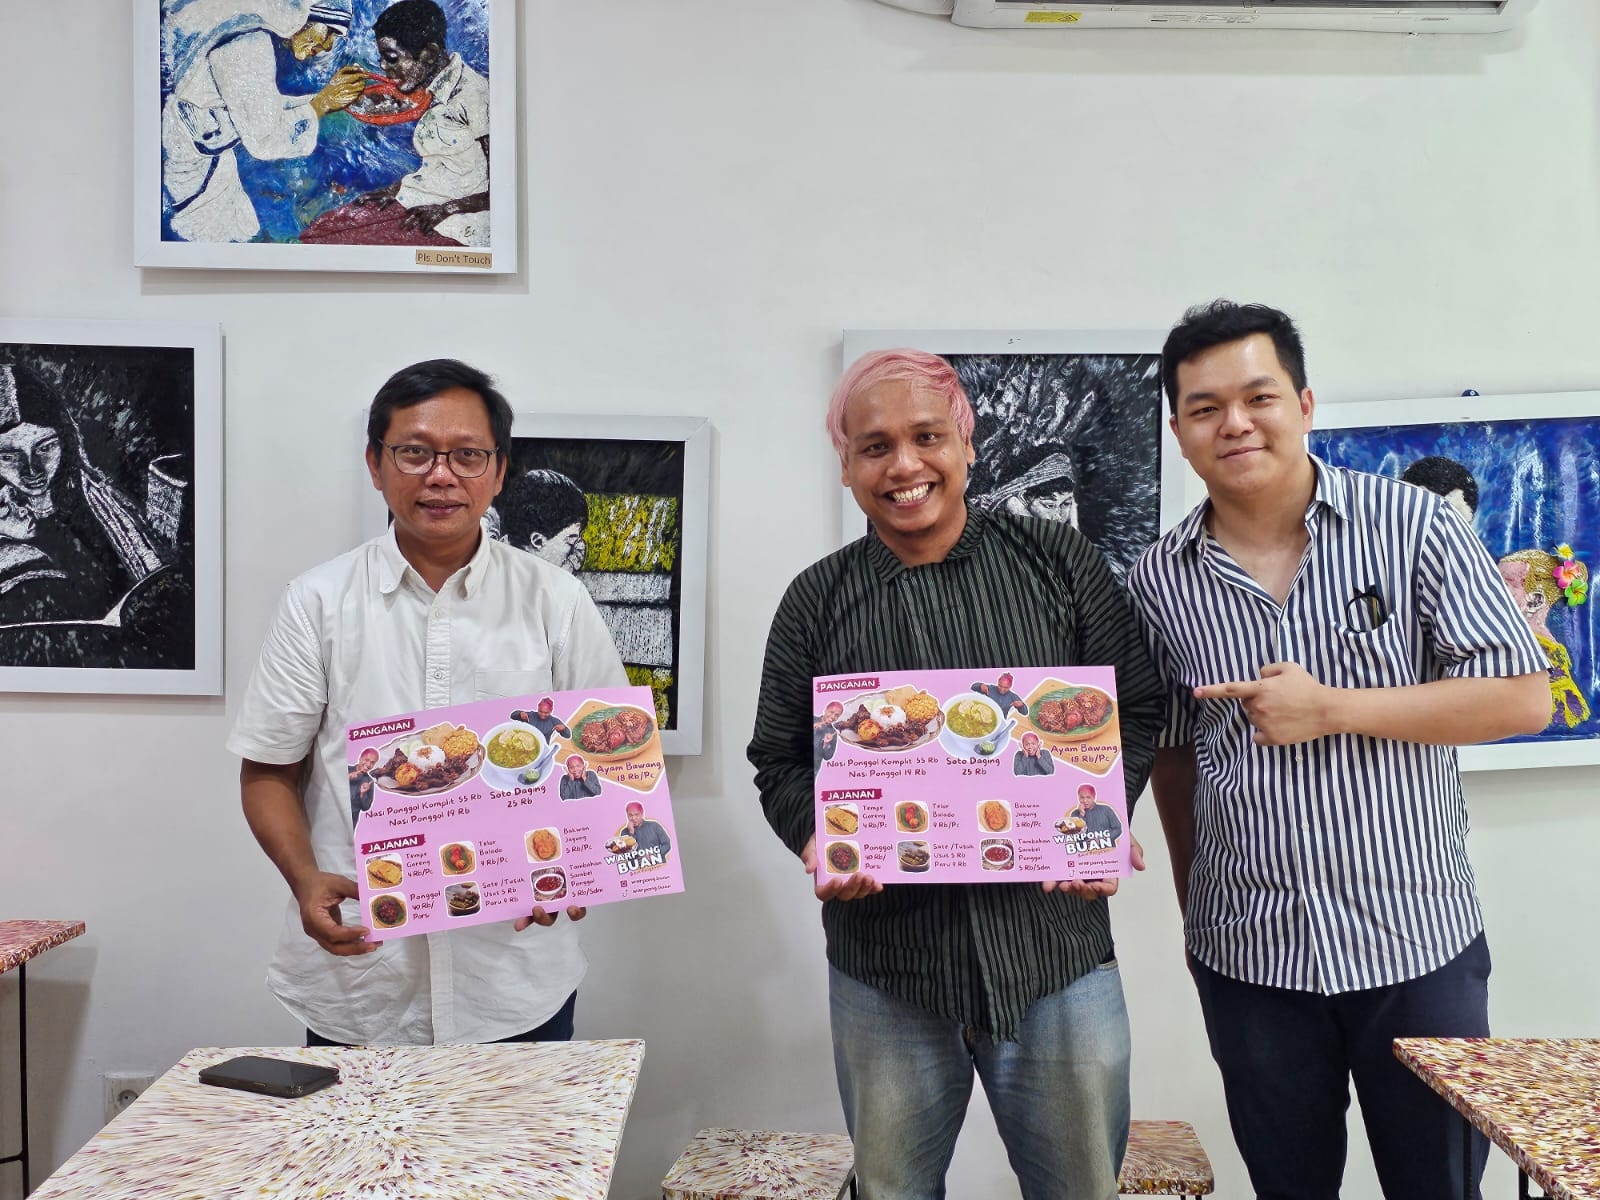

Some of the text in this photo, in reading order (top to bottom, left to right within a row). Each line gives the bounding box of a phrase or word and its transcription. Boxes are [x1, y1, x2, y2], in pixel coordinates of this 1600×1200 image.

[417, 253, 491, 264] Pls. Don't Touch
[820, 680, 875, 691] PANGANAN
[353, 721, 410, 739] PANGANAN
[1051, 744, 1118, 755] Ayam Bawang
[881, 758, 912, 767] Komplit
[946, 757, 1000, 766] Soto Daging
[1082, 754, 1110, 763] Rb/Pc
[597, 761, 662, 775] Ayam Bawang
[962, 768, 987, 776] 25 Rb
[617, 771, 655, 782] 18 Rb/Pc
[490, 785, 546, 800] Soto Daging
[828, 790, 875, 800] JAJANAN
[365, 810, 385, 819] Nasi
[422, 798, 455, 810] Komplit
[507, 800, 518, 808] 25
[389, 819, 408, 827] Nasi
[458, 807, 470, 815] Rb
[1053, 829, 1111, 844] WARPONG
[368, 837, 418, 853] JAJANAN
[1065, 838, 1112, 855] BUAN
[605, 845, 661, 865] WARPONG
[406, 860, 431, 868] Goreng
[617, 854, 663, 875] BUAN
